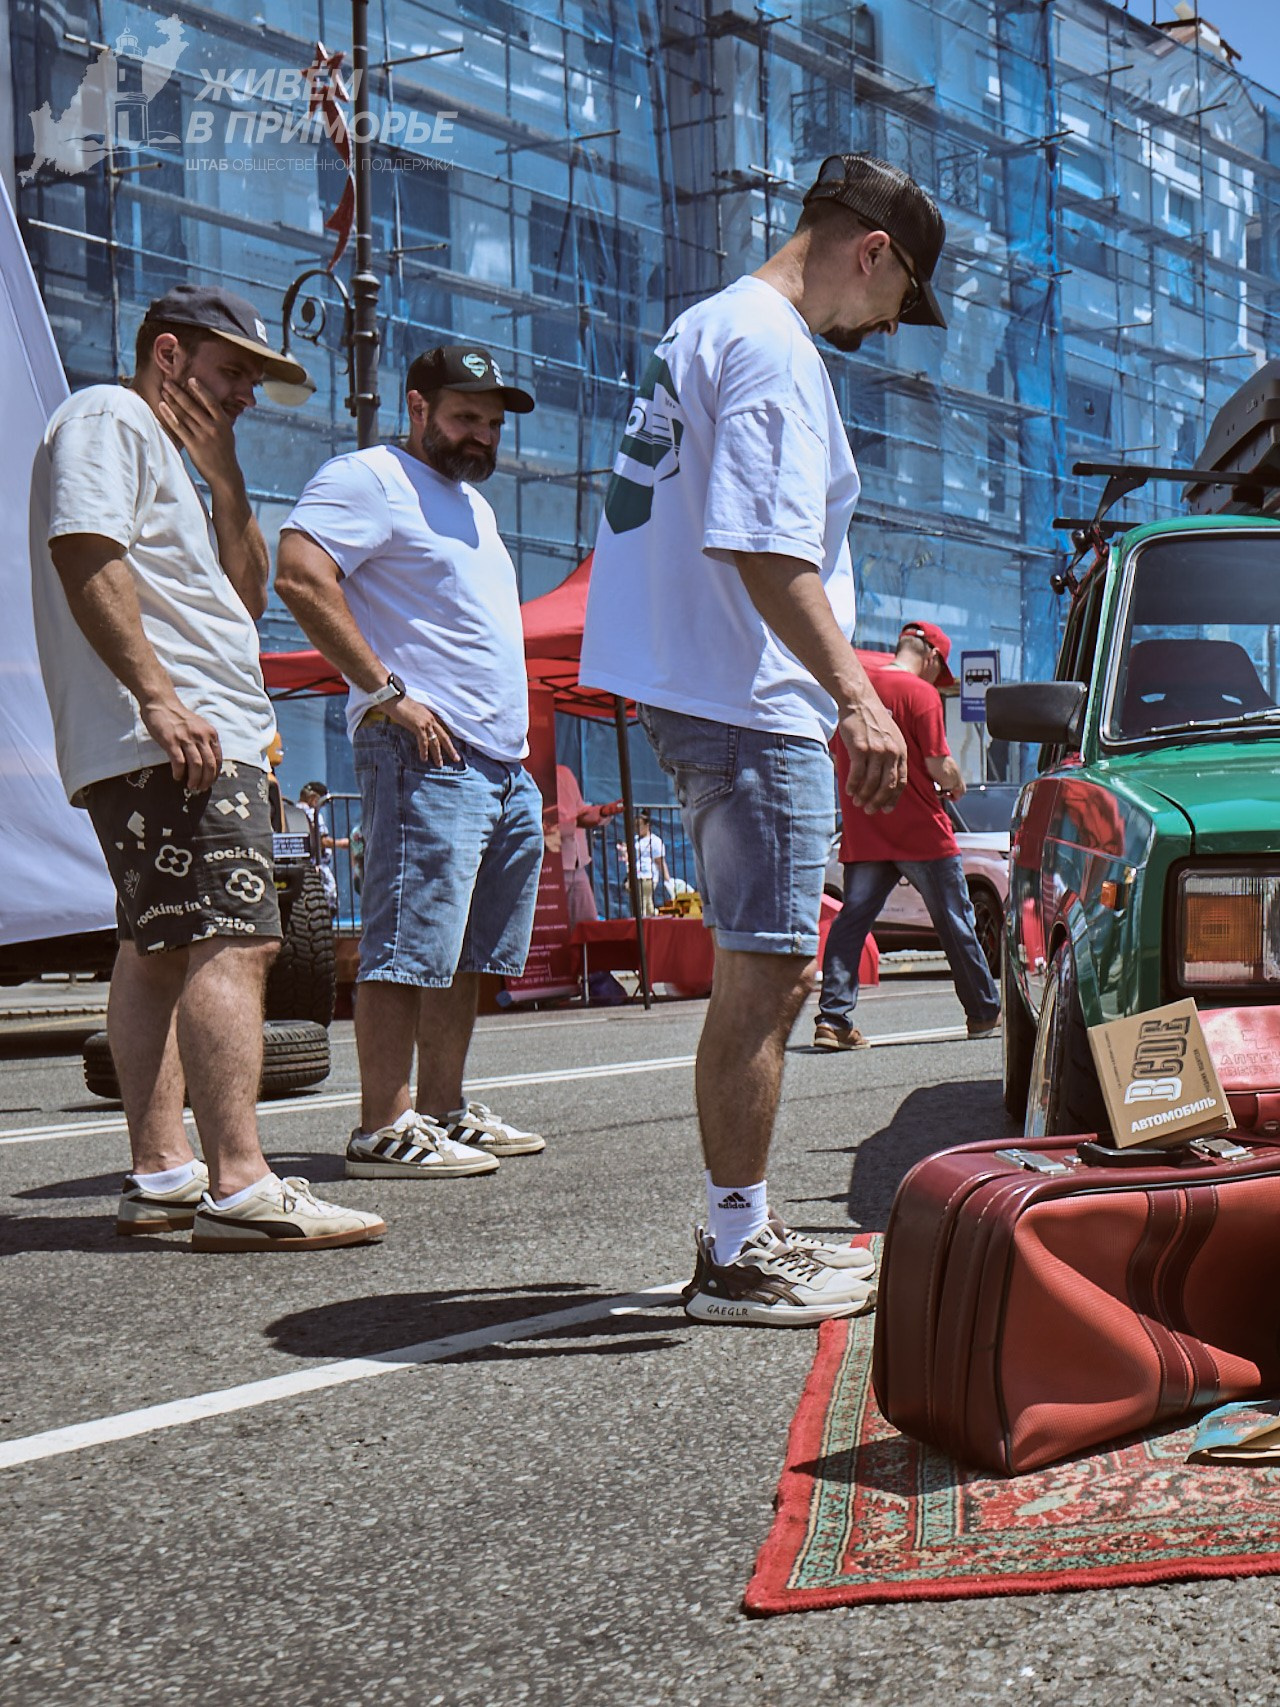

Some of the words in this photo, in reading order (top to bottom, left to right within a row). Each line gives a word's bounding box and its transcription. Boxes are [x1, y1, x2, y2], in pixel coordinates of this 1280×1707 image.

[137, 903, 184, 928] rocking
[184, 901, 202, 912] in
[1131, 1097, 1217, 1133] АВТОМОБИЛЬ
[706, 1304, 749, 1316] GAEGLR
